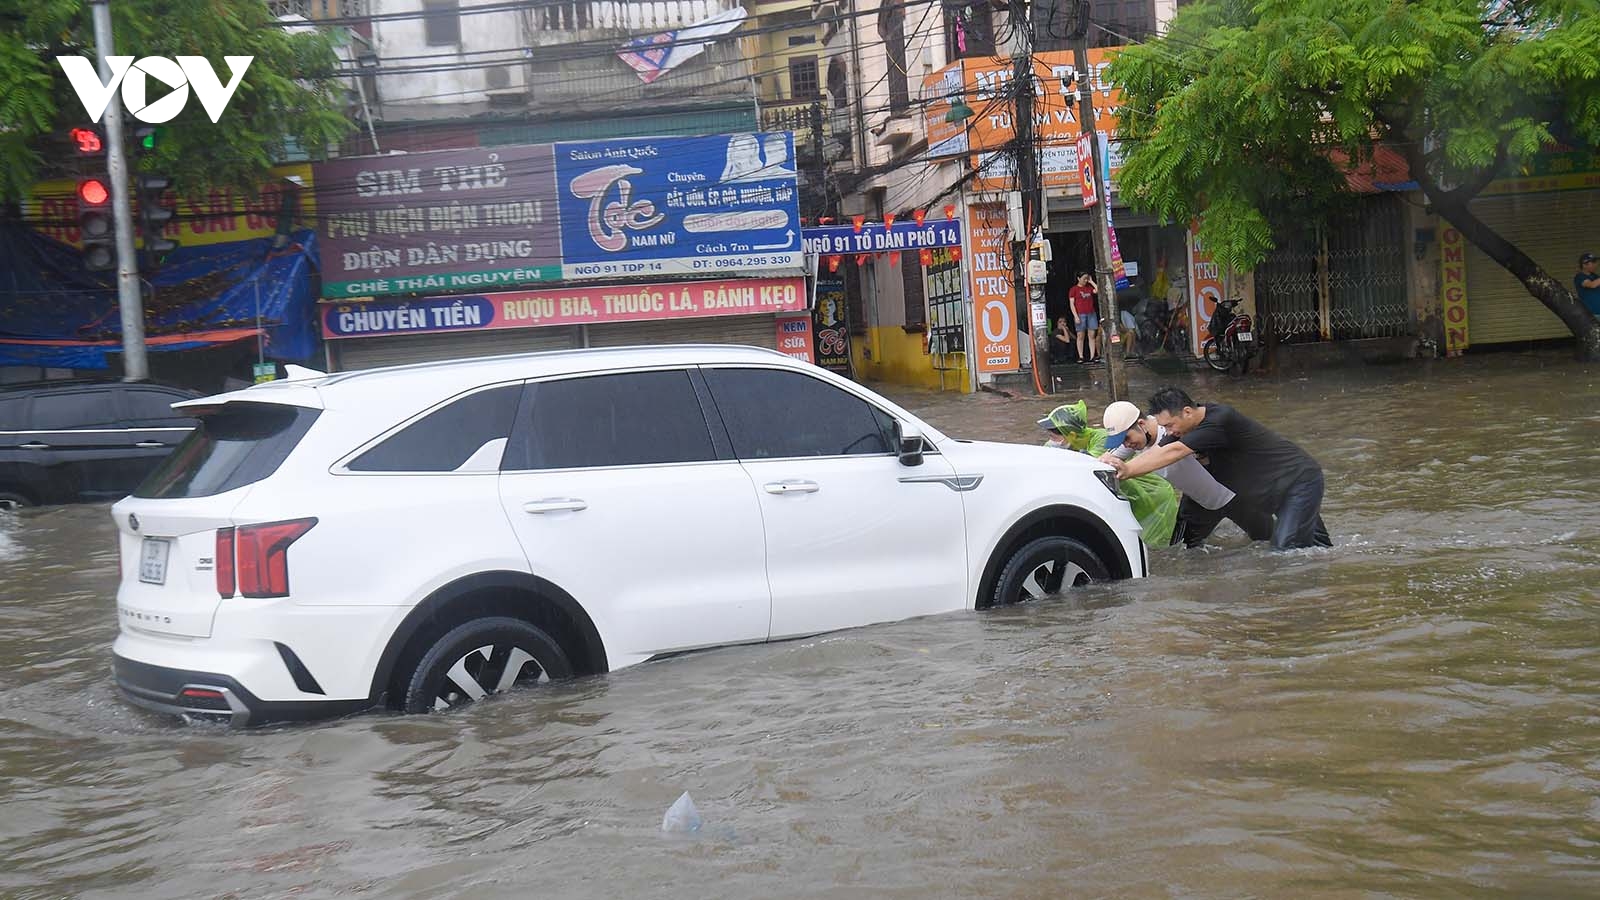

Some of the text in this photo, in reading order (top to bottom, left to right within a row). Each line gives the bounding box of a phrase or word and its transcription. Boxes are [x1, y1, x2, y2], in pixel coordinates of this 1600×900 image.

[356, 153, 507, 197] SIM THẺ
[327, 200, 543, 241] PHỤ KIỆN ĐIỆN THOẠI
[631, 231, 676, 247] NAM NỮ
[696, 243, 749, 253] Cách 7m
[802, 225, 957, 253] NGÕ 91 TỔ DÂN PHỐ 14
[343, 240, 532, 273] ĐIỆN DÂN DỤNG
[693, 255, 791, 268] ĐT: 0964.295 330
[575, 263, 662, 275] NGÕ 91 TDP 14
[346, 267, 541, 294] CHÈ THÁI NGUYÊN
[976, 277, 1009, 297] TRỌ
[504, 285, 796, 323] RƯỢU BIA, THUỐC LÁ, BÁNH KẸO
[339, 300, 480, 332] CHUYỂN TIỀN
[783, 321, 806, 332] KEM
[784, 335, 806, 348] SỮA
[984, 342, 1012, 355] đồng
